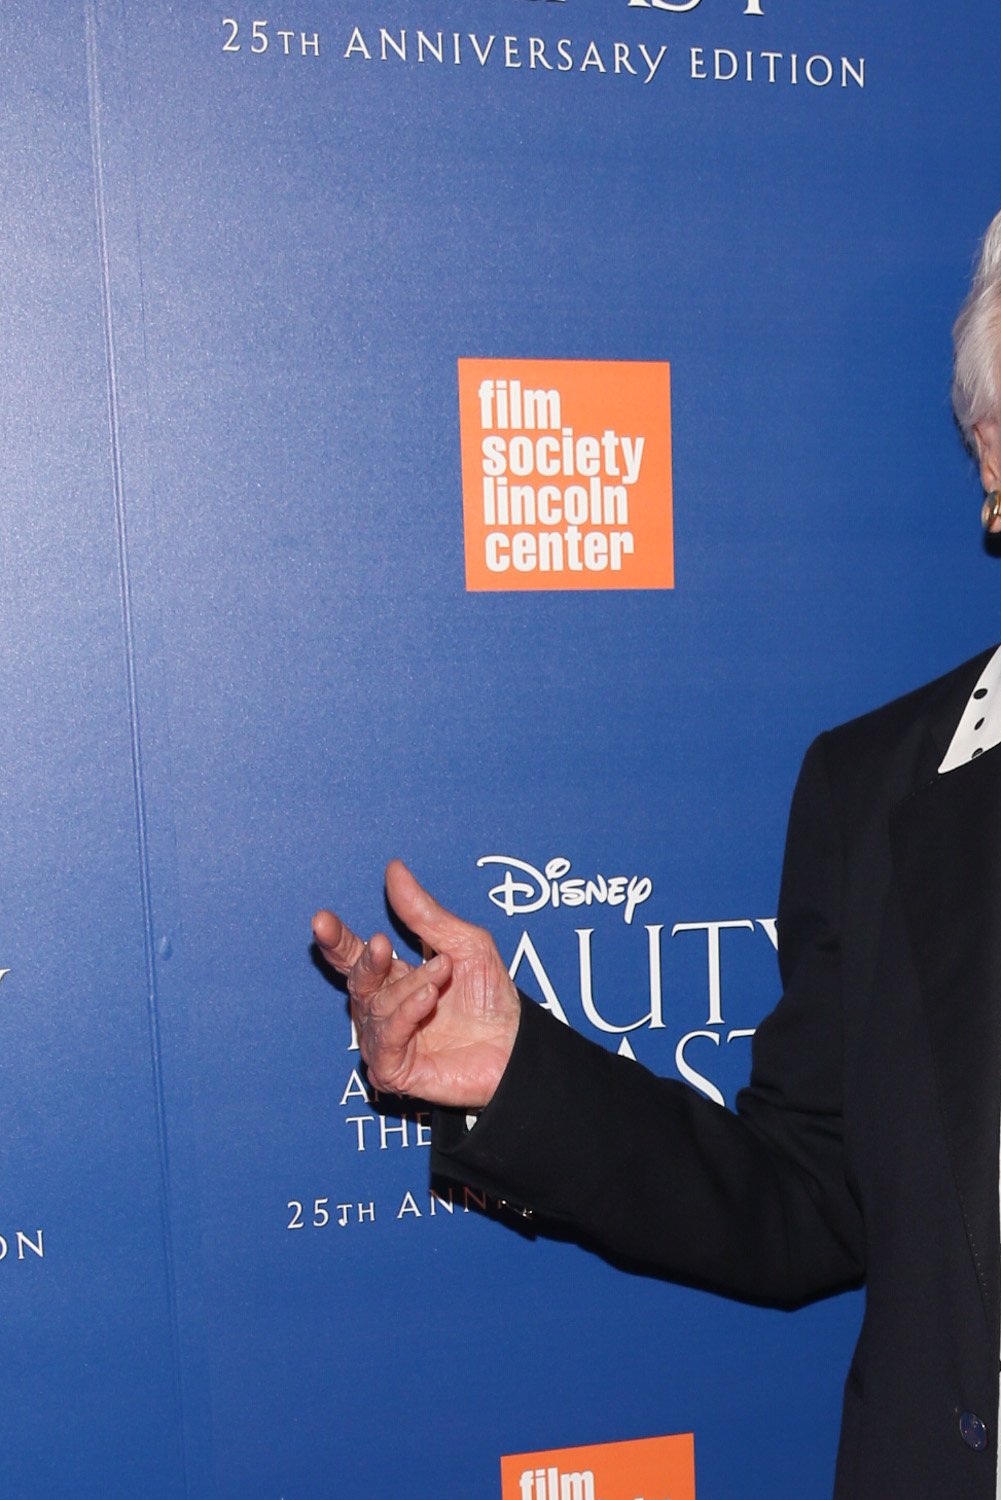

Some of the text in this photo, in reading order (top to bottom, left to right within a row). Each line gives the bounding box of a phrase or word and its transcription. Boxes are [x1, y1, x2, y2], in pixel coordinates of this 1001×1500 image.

[221, 19, 866, 88] 25TH ANNIVERSARY EDITION
[478, 379, 562, 430] film
[481, 427, 645, 485] society
[482, 476, 629, 526] lincoln
[484, 525, 634, 573] center
[477, 855, 653, 924] Disney
